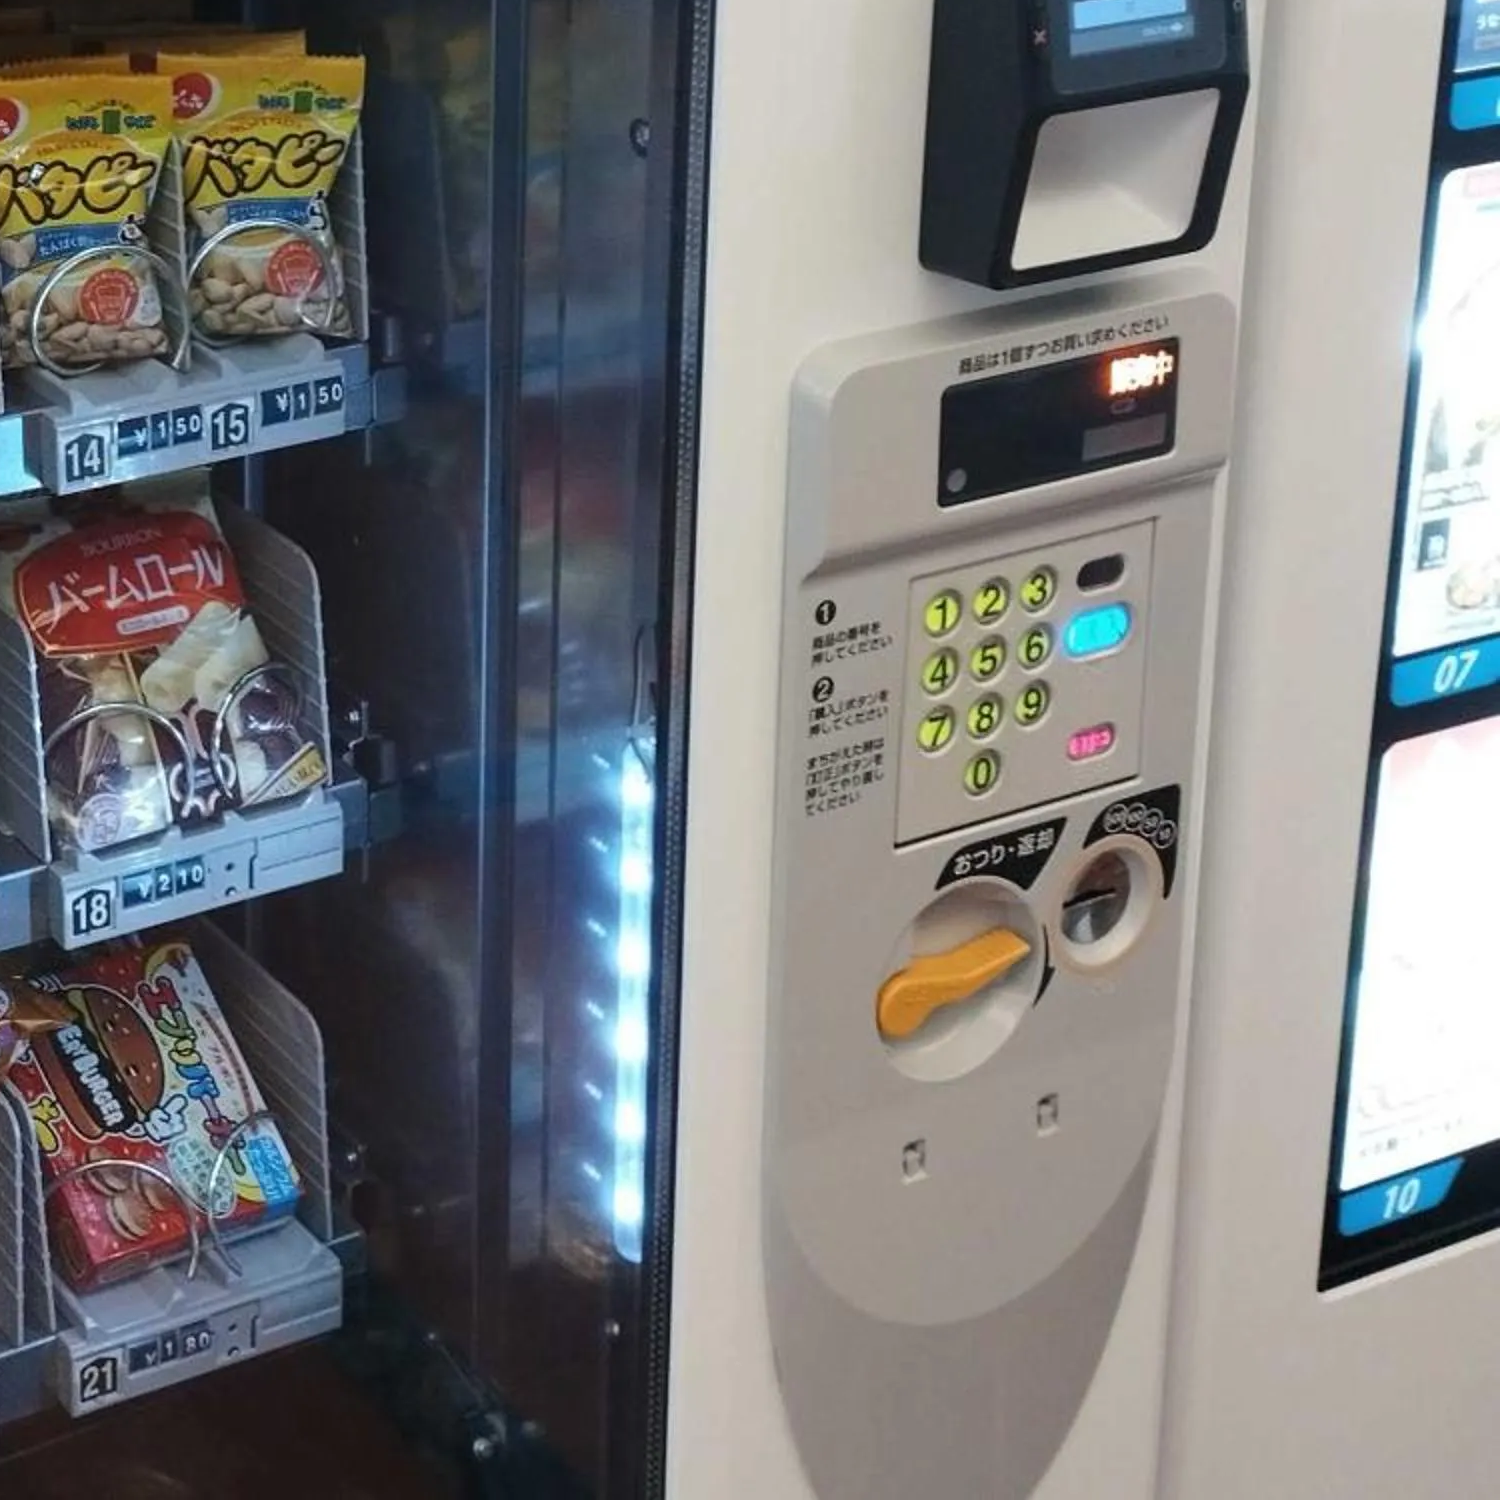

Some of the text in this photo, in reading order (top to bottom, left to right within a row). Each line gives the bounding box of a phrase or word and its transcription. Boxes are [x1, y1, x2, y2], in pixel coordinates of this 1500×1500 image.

[181, 129, 346, 206] バタピー
[957, 315, 1170, 377] 商品は1個ずつお買い求めください
[213, 381, 344, 444] 15 ¥150
[67, 415, 201, 477] 14 ¥150
[40, 547, 225, 634] バームロール
[934, 575, 1047, 627] 1 2 3
[929, 657, 949, 687] 4
[979, 645, 998, 675] 5
[1026, 631, 1042, 661] 6
[1433, 649, 1479, 694] 07
[930, 686, 1042, 747] 7 8 9
[972, 757, 991, 788] 0
[952, 826, 1056, 876] おつり・返却
[74, 892, 111, 933] 18
[135, 976, 248, 1176] エブリバーガー
[1381, 1177, 1420, 1218] 10
[80, 1363, 114, 1401] 21
